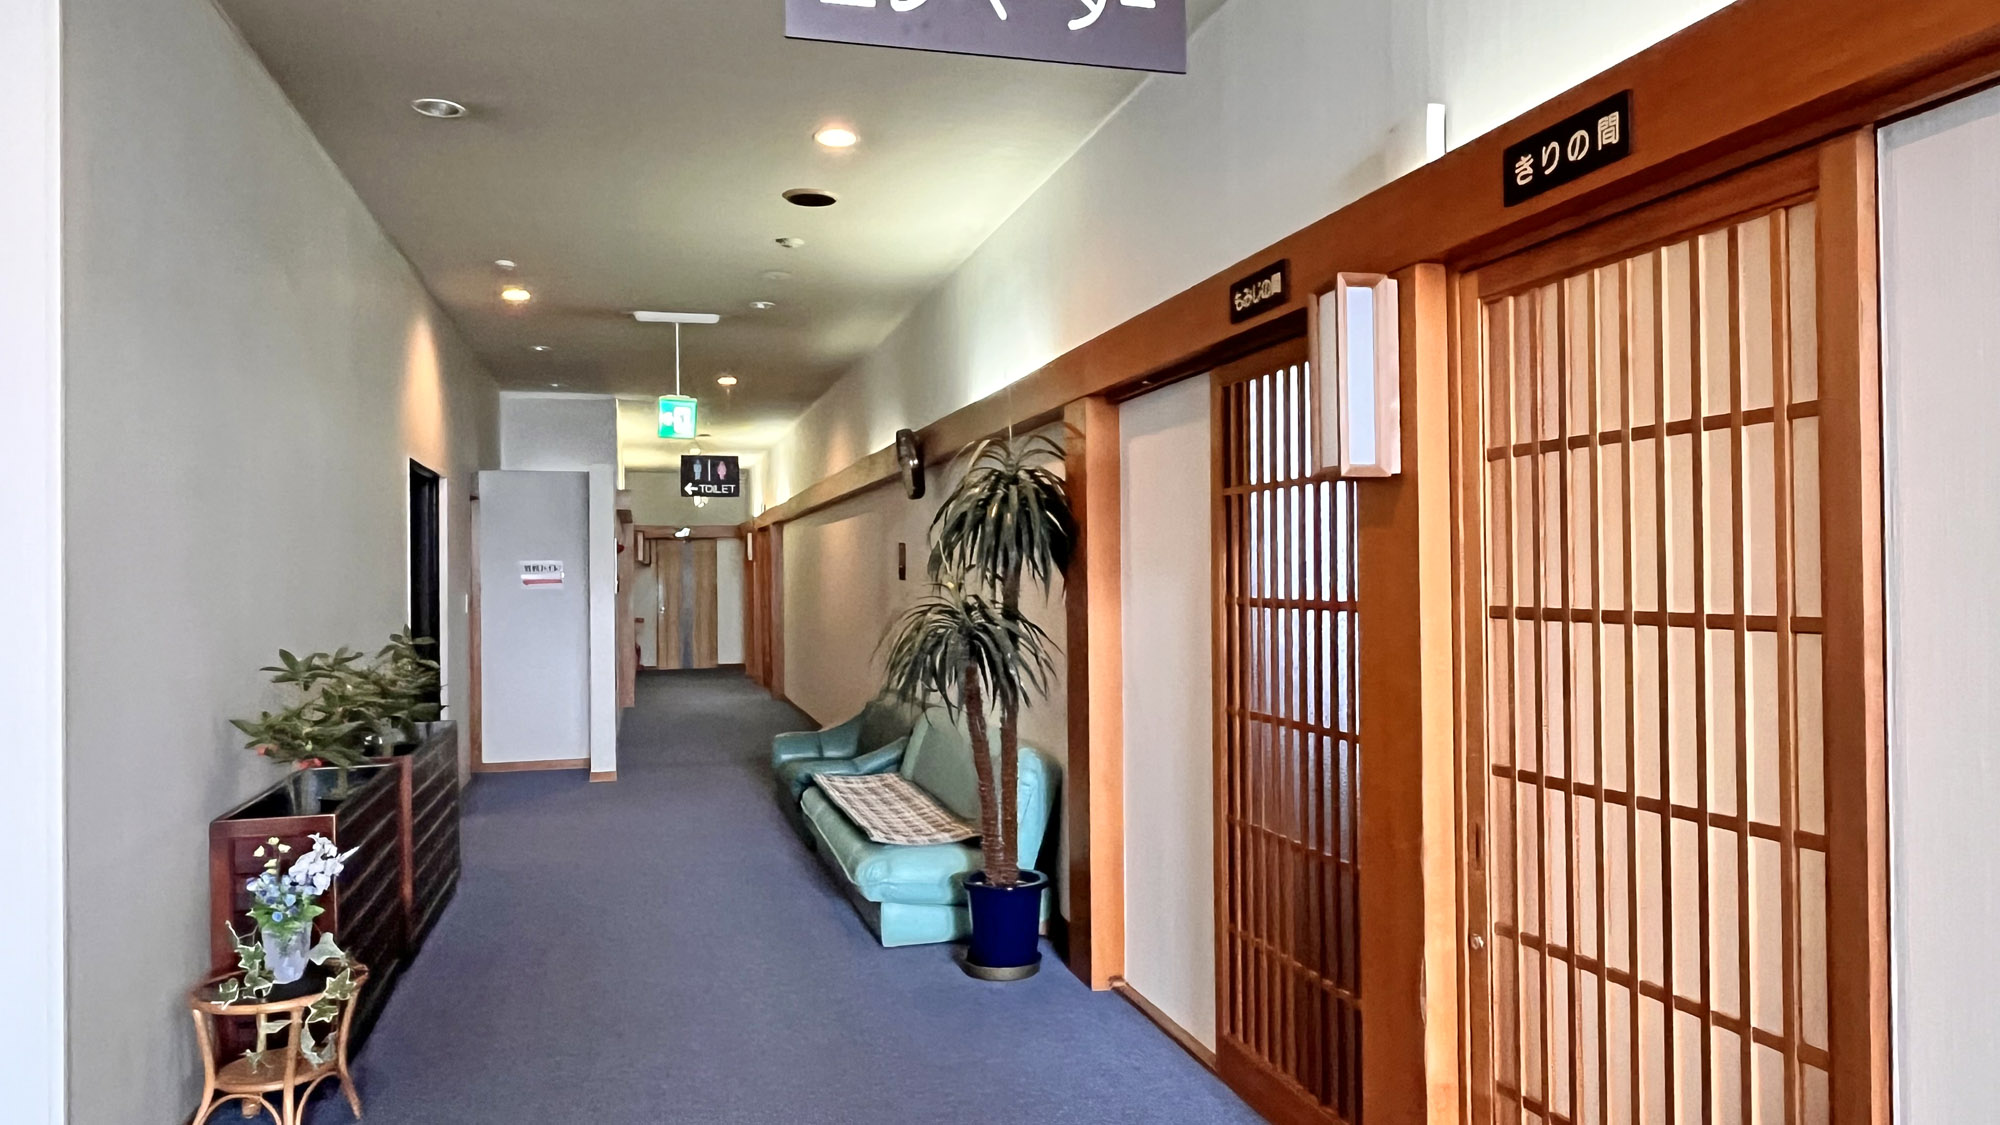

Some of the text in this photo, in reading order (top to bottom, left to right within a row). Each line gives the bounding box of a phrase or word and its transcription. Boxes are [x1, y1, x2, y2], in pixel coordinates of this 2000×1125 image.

[1514, 111, 1620, 186] きりの間
[1234, 271, 1282, 312] もみじの
[698, 483, 737, 494] TOILET
